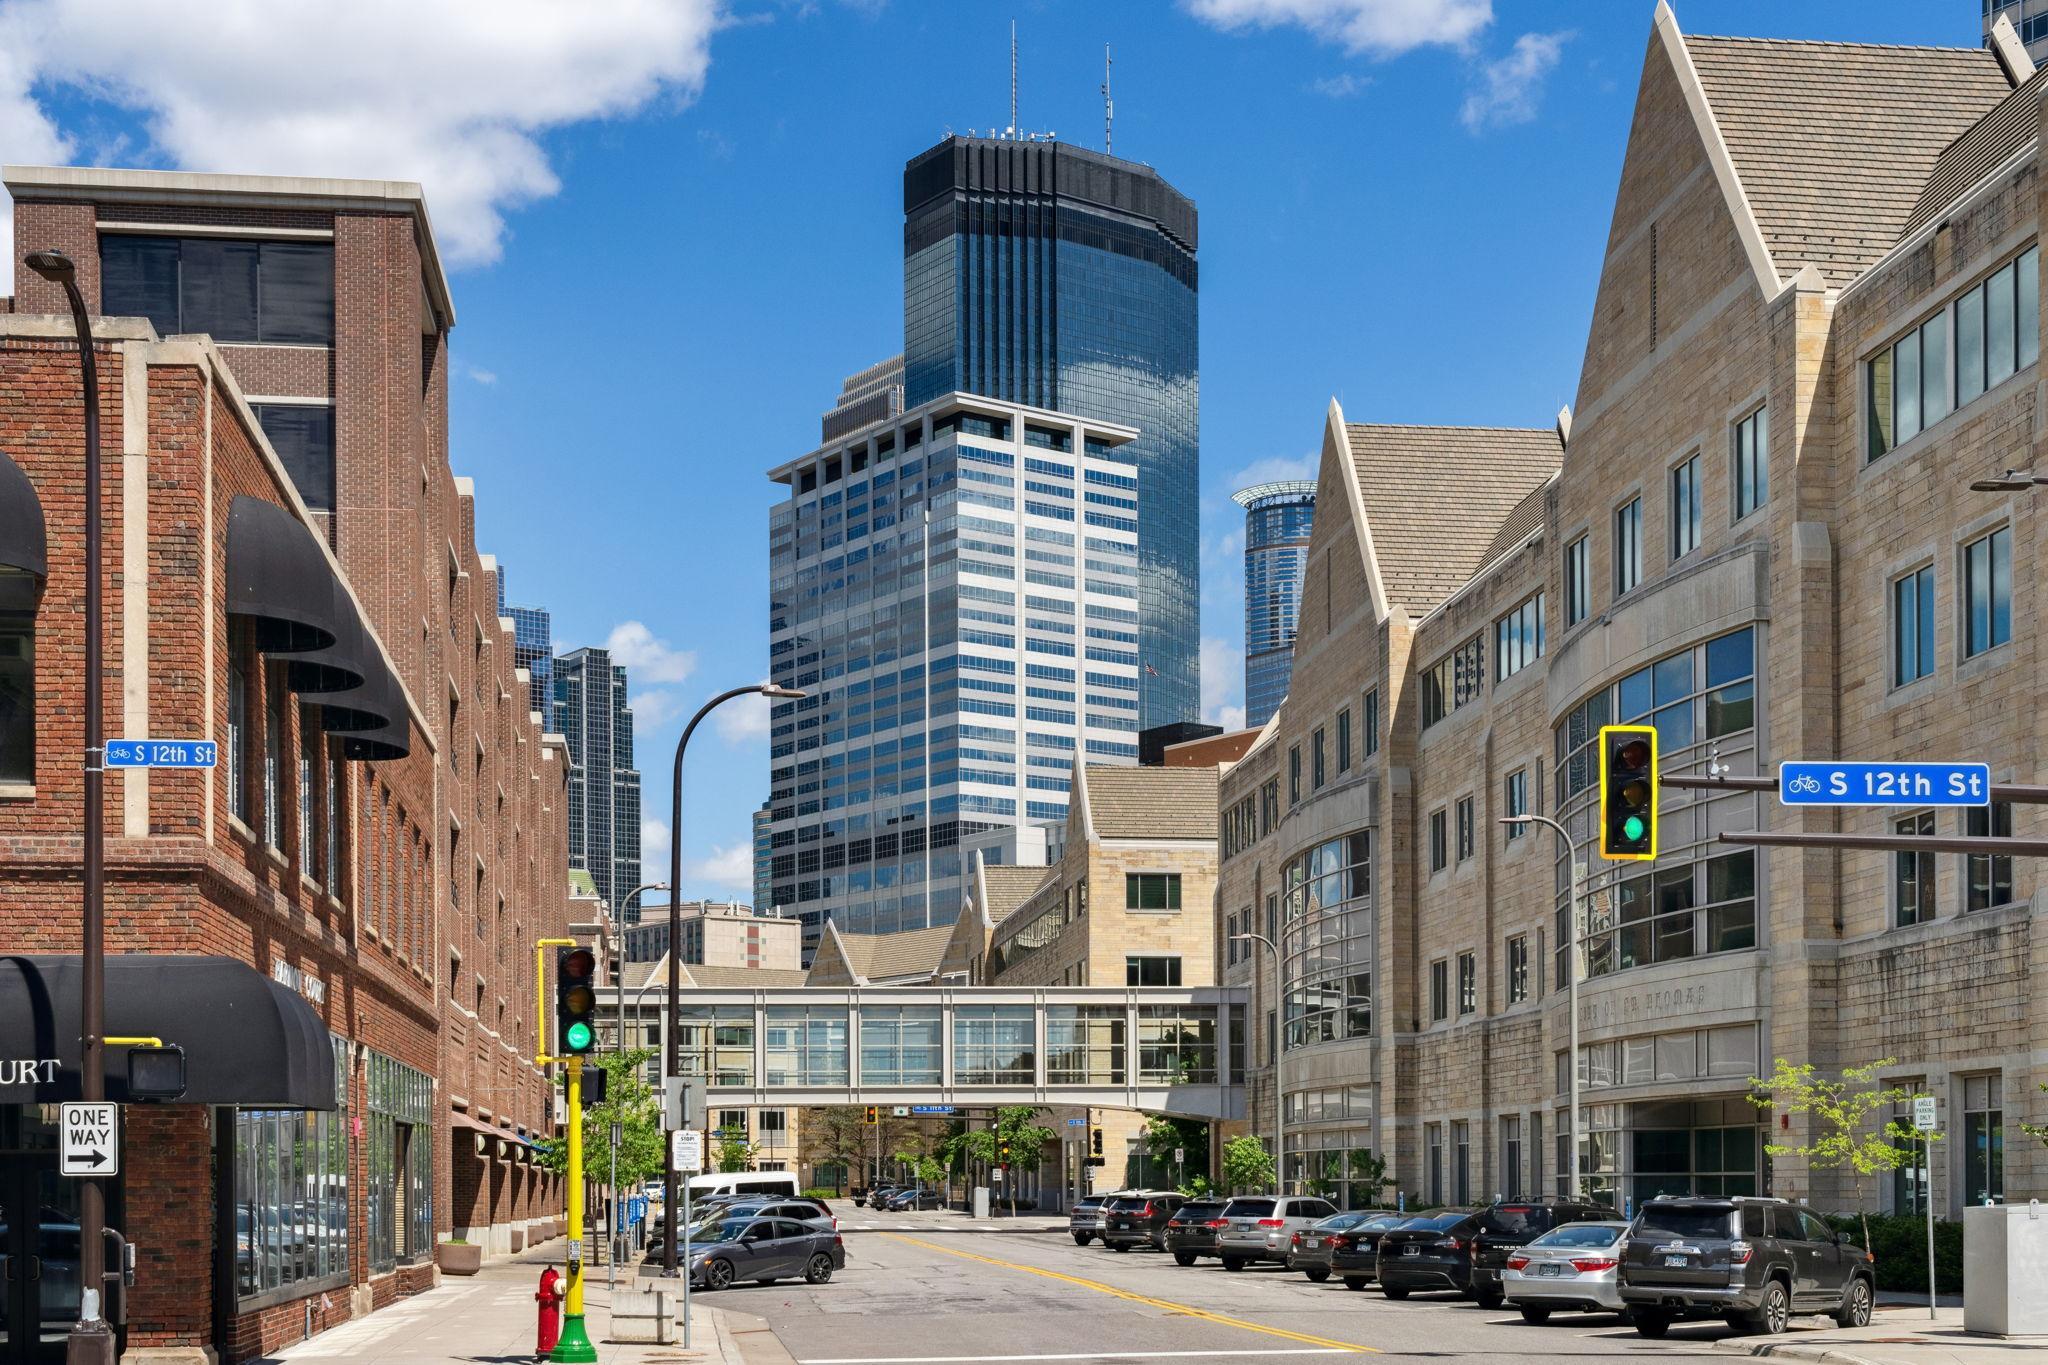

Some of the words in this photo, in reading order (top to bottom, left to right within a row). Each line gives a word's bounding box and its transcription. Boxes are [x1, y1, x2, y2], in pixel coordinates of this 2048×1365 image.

[135, 745, 145, 762] S
[152, 745, 187, 762] 12th
[194, 746, 212, 763] St
[1829, 771, 1848, 796] S
[1864, 771, 1931, 796] 12th
[1948, 772, 1981, 797] St
[0, 1058, 61, 1085] URT
[69, 1109, 109, 1126] ONE
[70, 1129, 110, 1146] WAY
